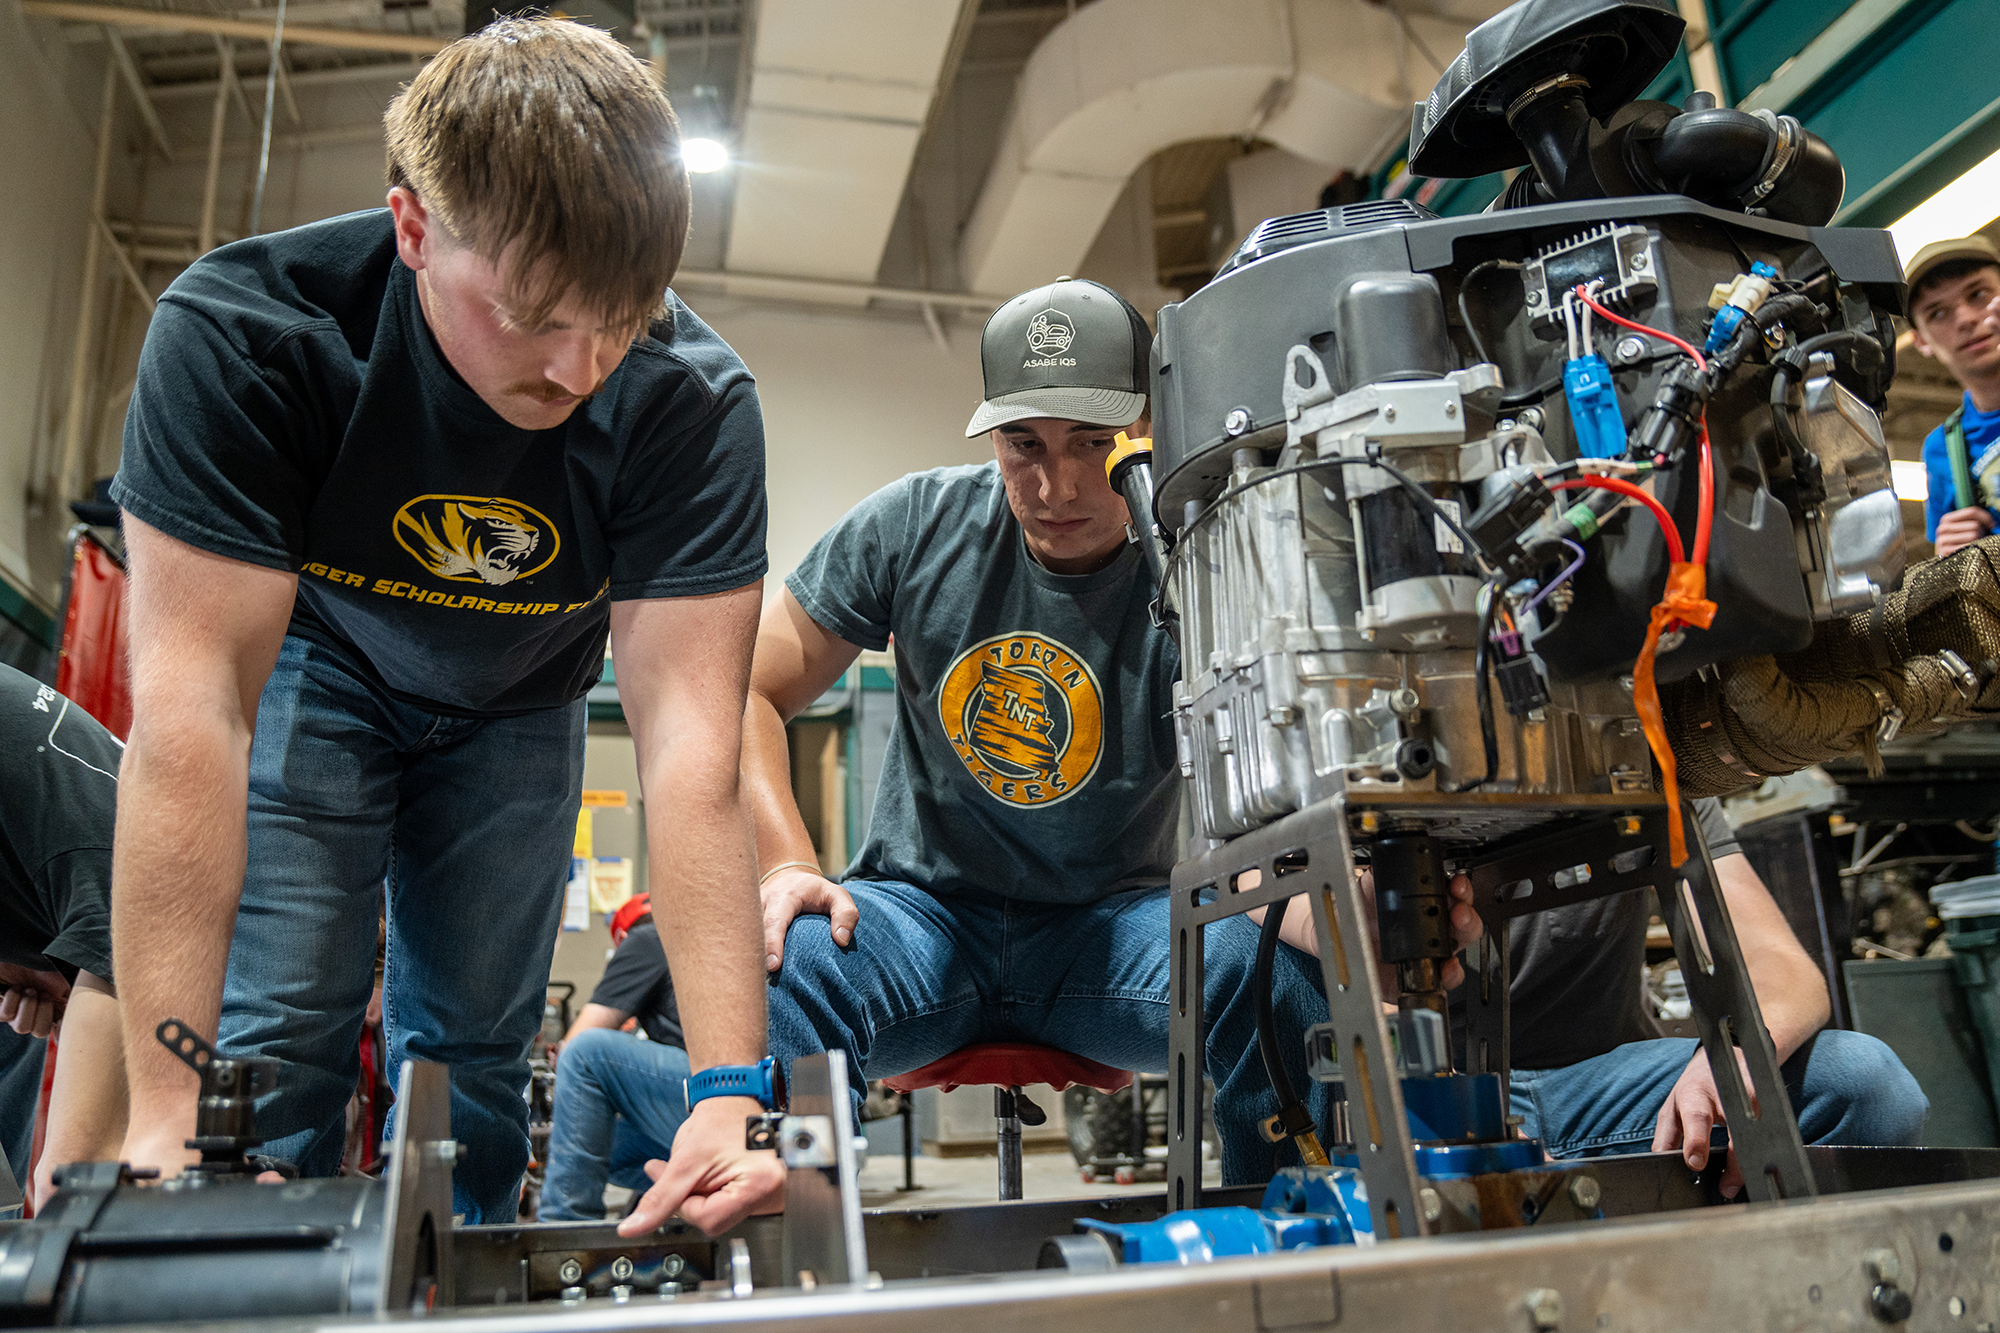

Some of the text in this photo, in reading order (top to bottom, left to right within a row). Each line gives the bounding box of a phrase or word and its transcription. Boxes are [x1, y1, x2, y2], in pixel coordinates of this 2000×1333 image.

[1022, 357, 1077, 369] ASABE IQS
[371, 579, 560, 615] SCHOLARSHIP
[1002, 689, 1038, 731] TNT
[950, 731, 1069, 801] TIGERS
